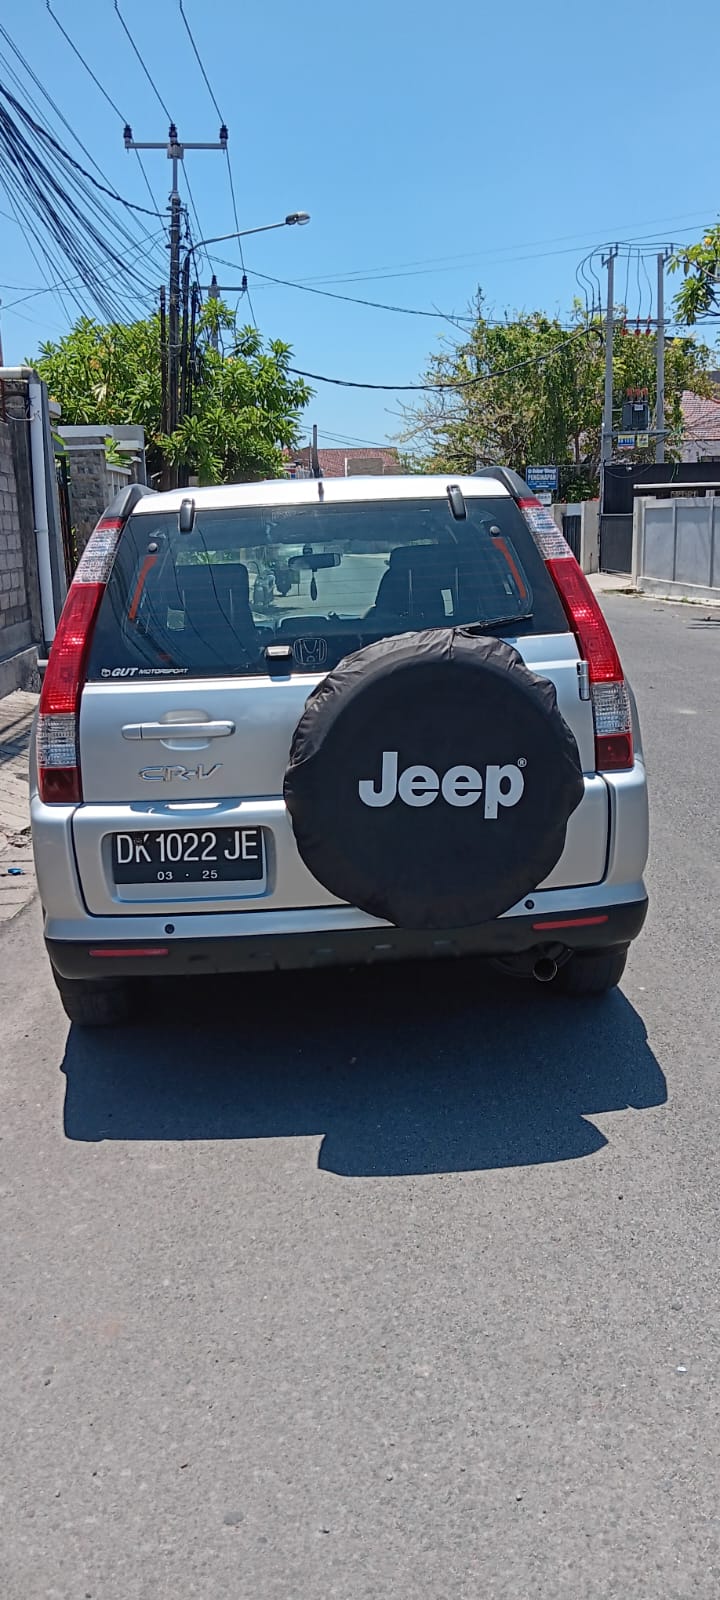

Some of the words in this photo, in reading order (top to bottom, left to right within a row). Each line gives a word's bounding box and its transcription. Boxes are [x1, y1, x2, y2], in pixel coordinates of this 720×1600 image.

[111, 667, 138, 677] GUT
[138, 763, 224, 782] CR-V
[358, 751, 525, 819] Jeep
[116, 833, 152, 864] DK
[155, 831, 218, 862] 1022
[223, 830, 258, 861] JE
[157, 871, 174, 881] 03
[202, 870, 218, 880] 25
